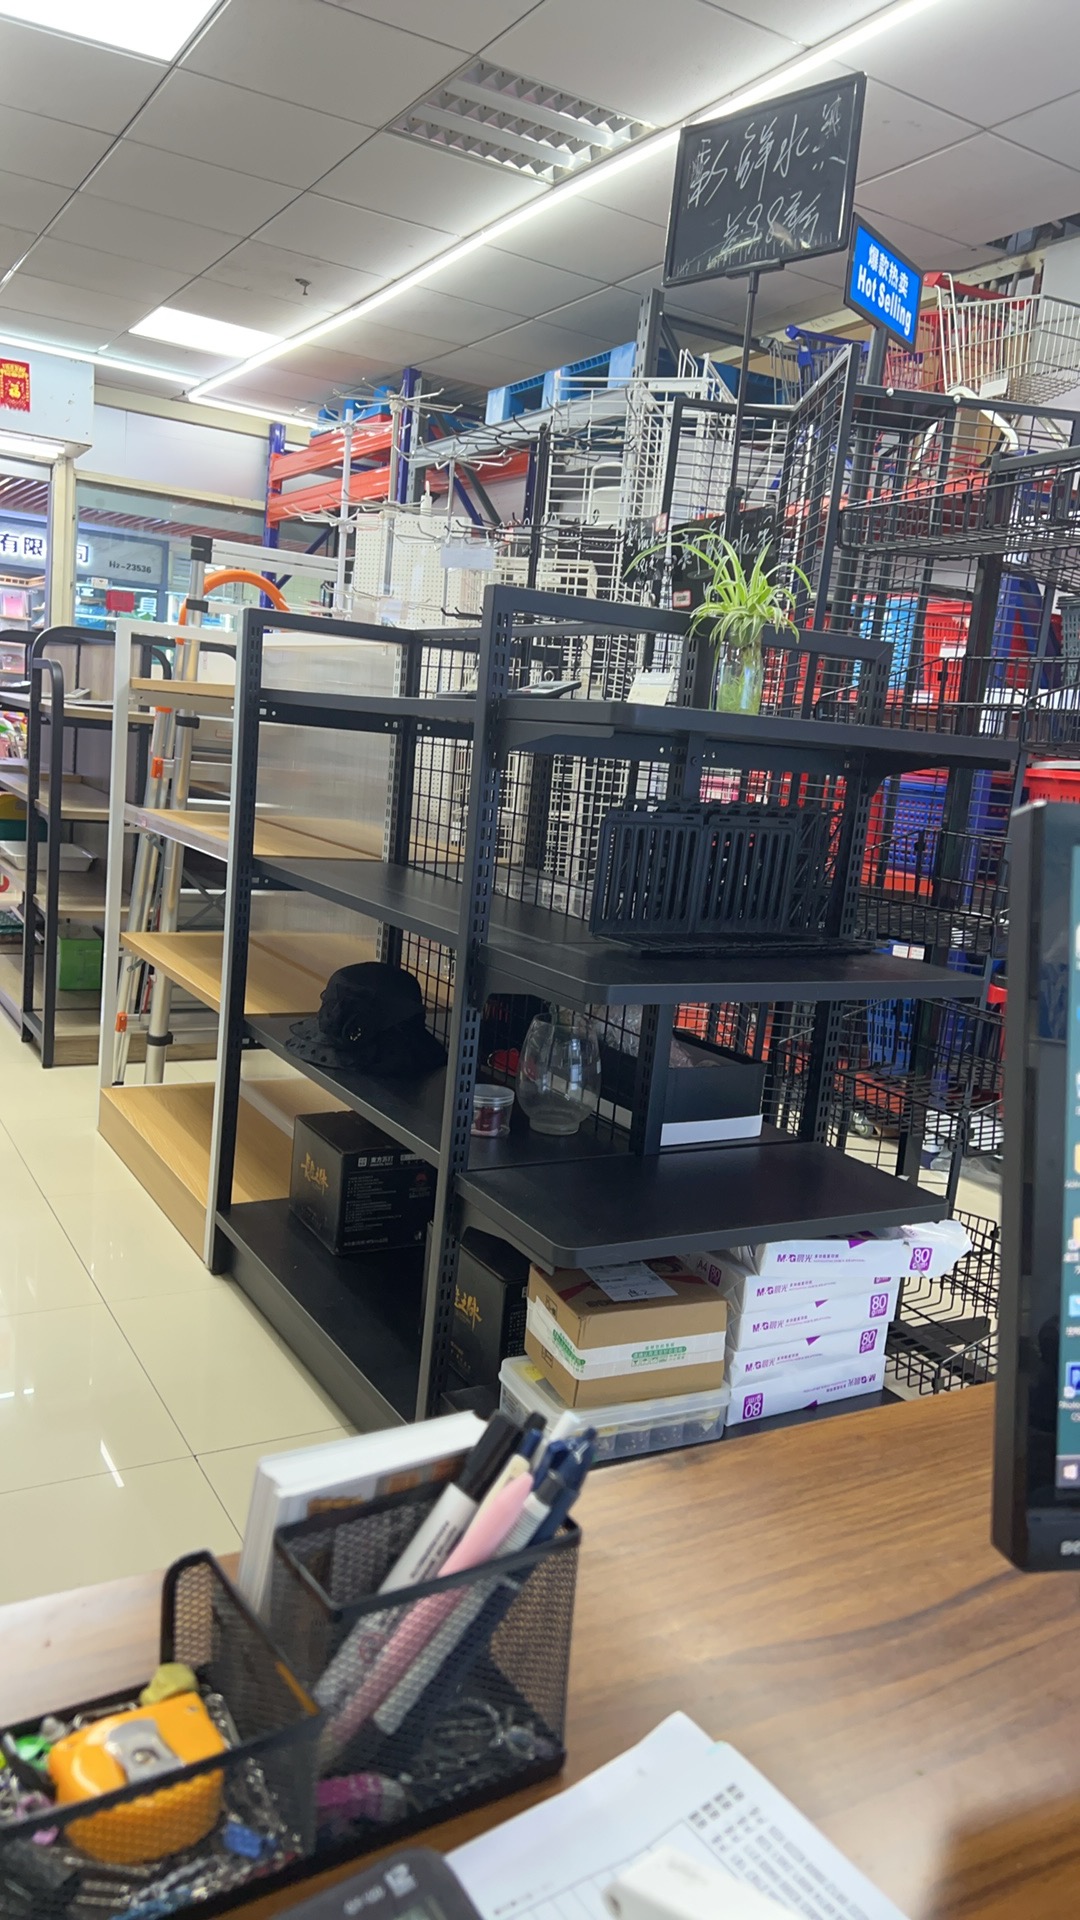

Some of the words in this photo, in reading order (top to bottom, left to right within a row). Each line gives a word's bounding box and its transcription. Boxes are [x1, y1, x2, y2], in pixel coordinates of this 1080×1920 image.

[868, 243, 909, 298] 爆款热卖
[857, 264, 877, 303] Hot
[877, 282, 912, 337] Selling
[914, 1248, 930, 1263] 80
[871, 1295, 887, 1310] 80
[861, 1330, 876, 1346] 80
[744, 1402, 761, 1418] 80
